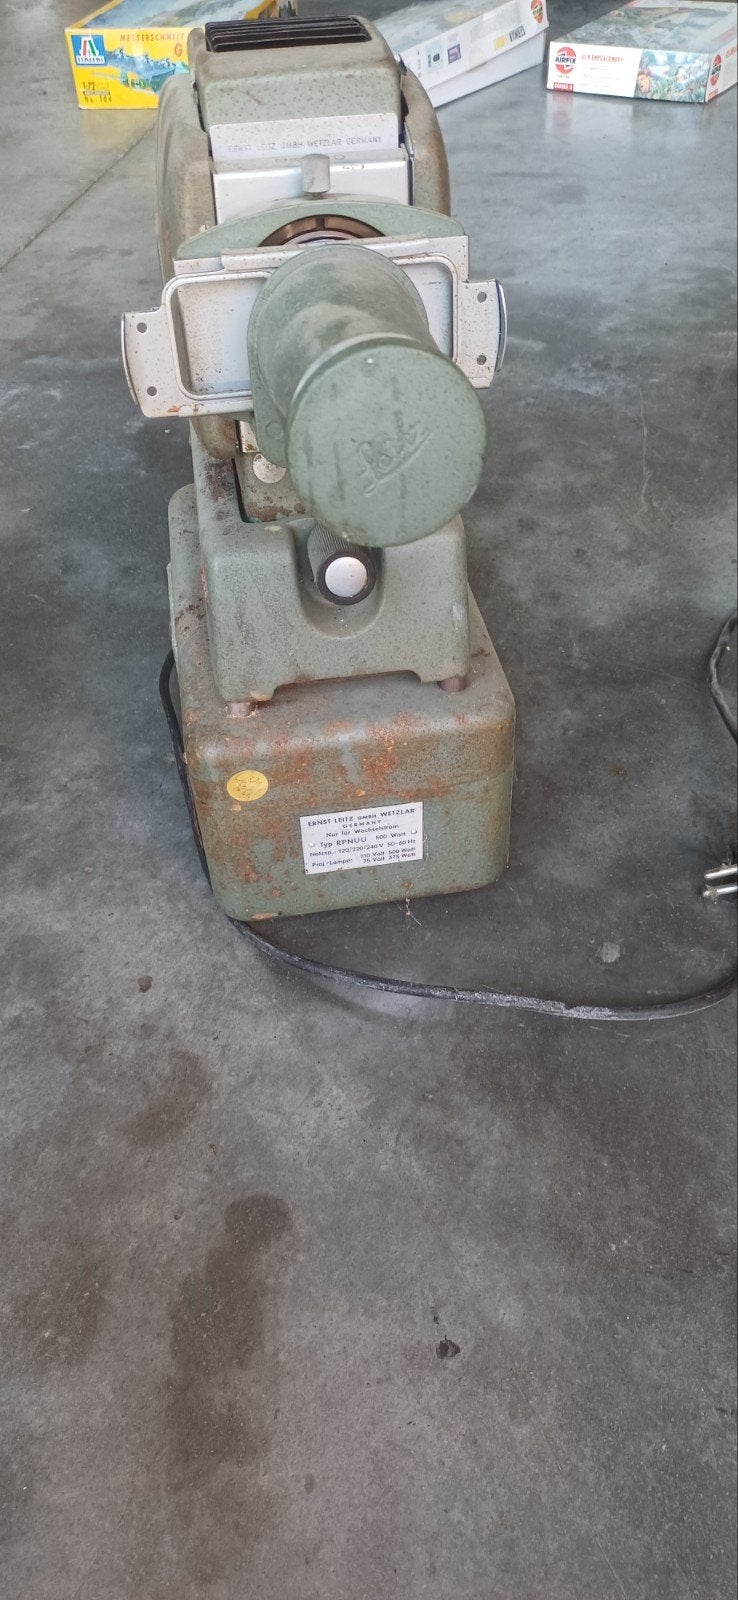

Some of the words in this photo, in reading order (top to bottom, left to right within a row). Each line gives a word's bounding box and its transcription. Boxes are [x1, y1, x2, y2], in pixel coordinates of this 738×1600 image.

[554, 56, 576, 64] AIRFIX
[281, 140, 303, 149] GMBH
[307, 138, 342, 147] WETZLAR
[346, 136, 382, 145] GERMANY
[308, 818, 331, 827] ERNST
[380, 808, 415, 817] WETZLAR
[342, 820, 382, 828] GERMANY
[354, 824, 399, 834] Wechselstrom
[336, 837, 367, 846] RPNUU
